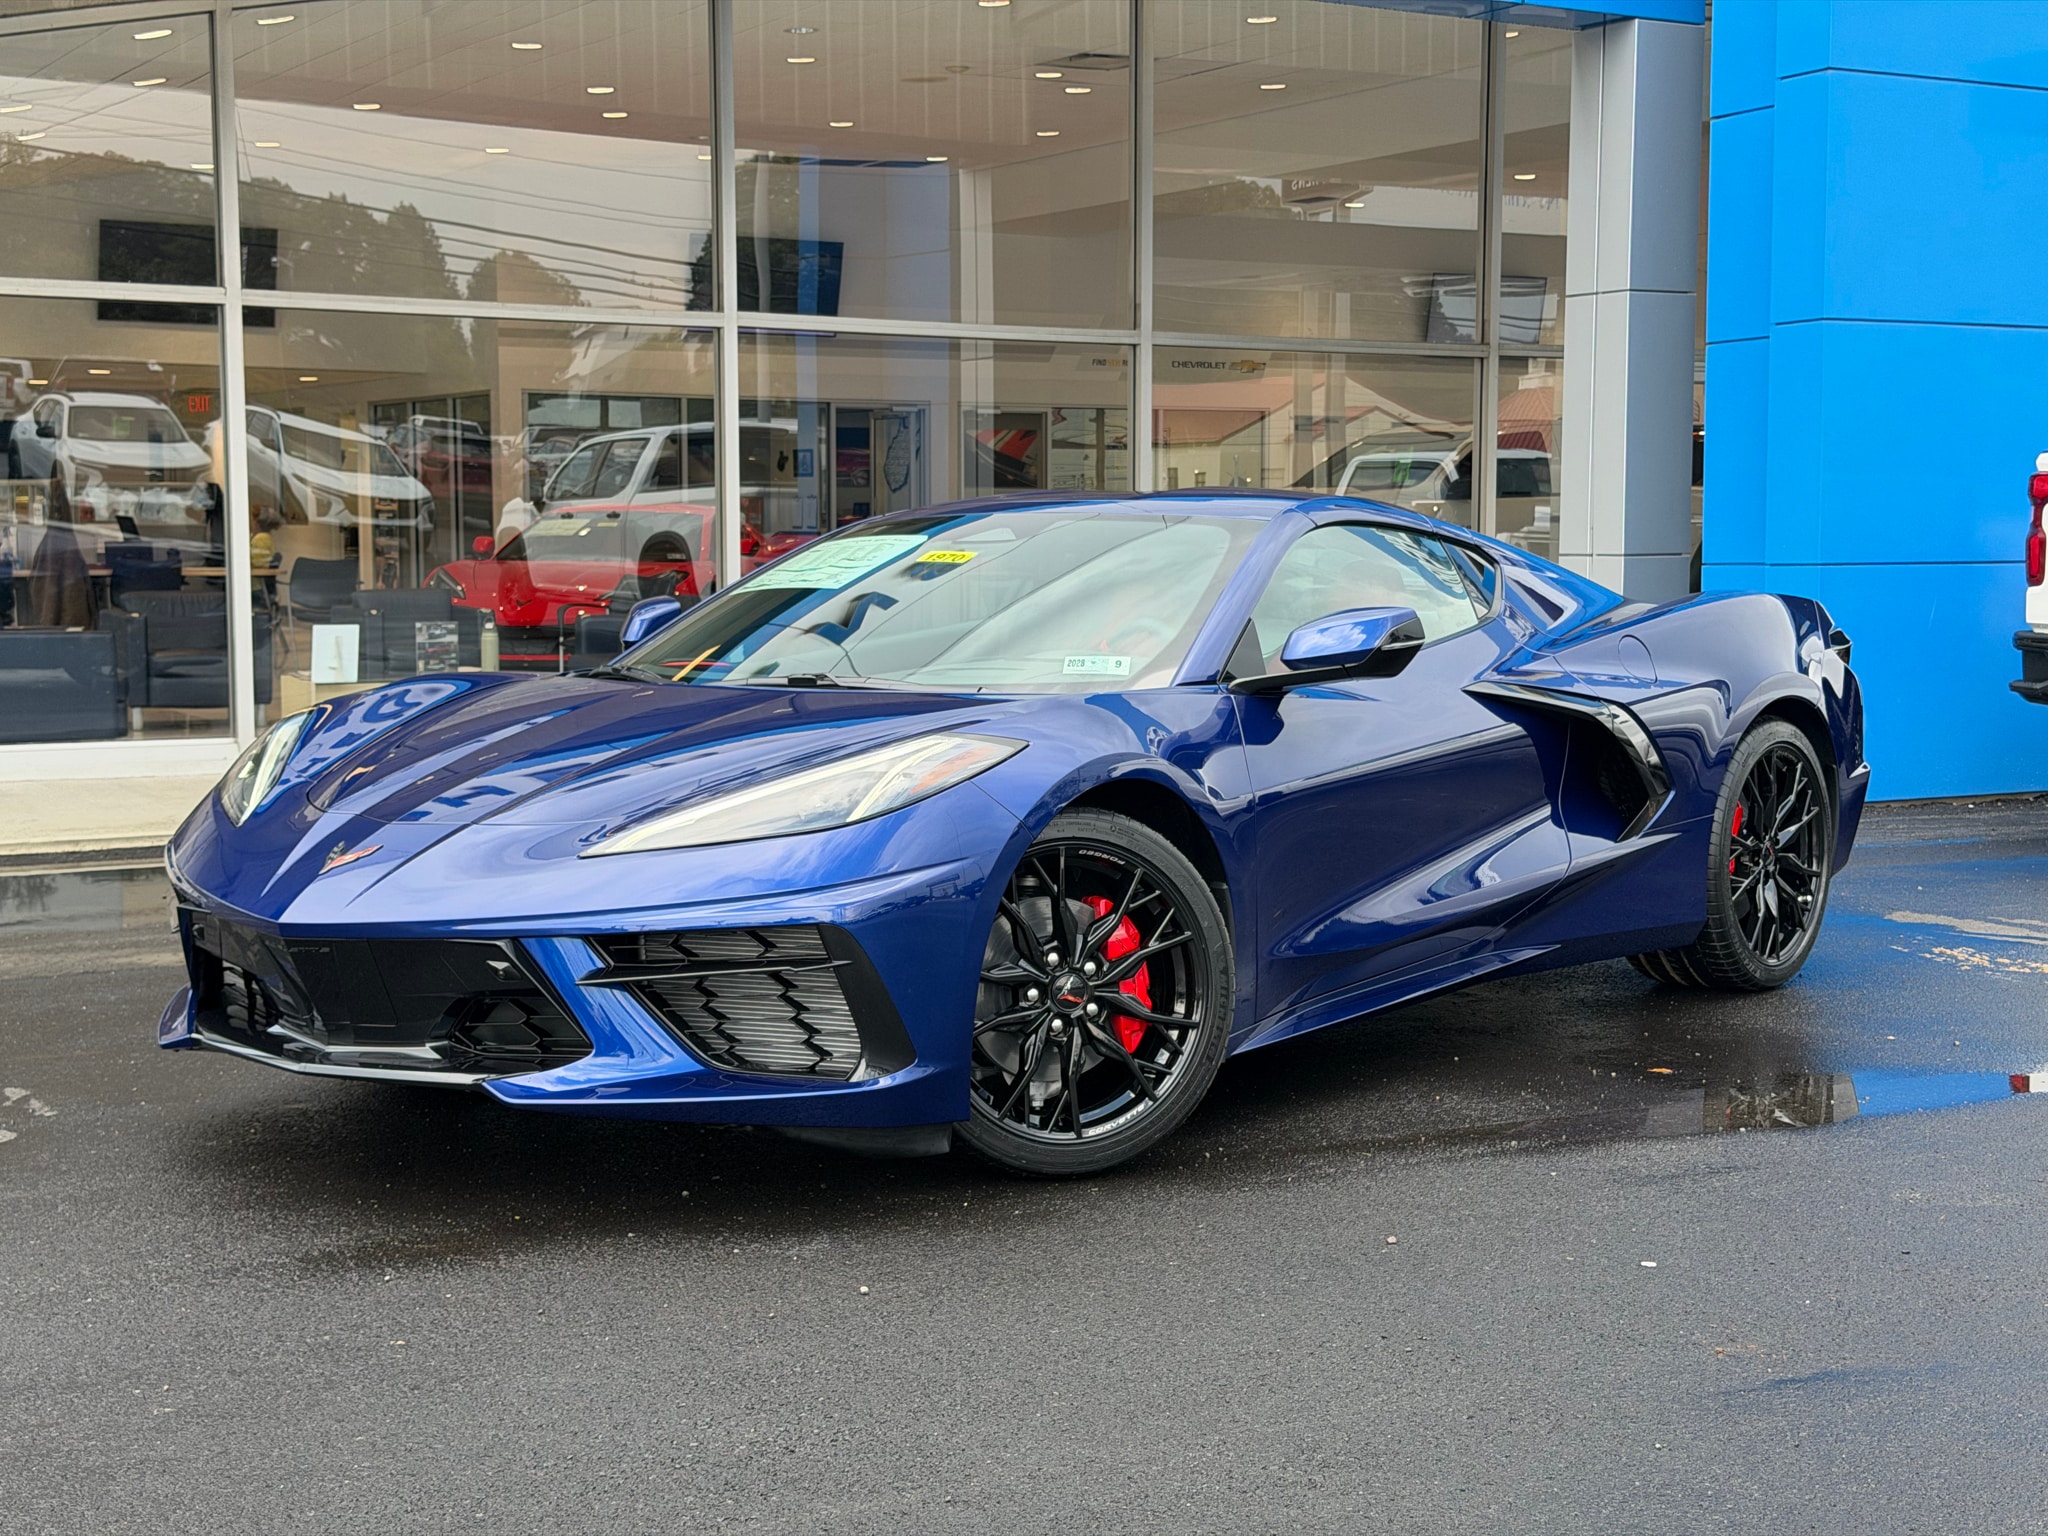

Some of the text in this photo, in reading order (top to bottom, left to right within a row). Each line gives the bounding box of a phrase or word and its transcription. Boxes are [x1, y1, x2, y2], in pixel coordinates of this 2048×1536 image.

[1171, 360, 1227, 370] CHEVROLET
[189, 396, 209, 412] EXIT
[1115, 660, 1122, 668] 9
[1078, 849, 1126, 865] FORGED
